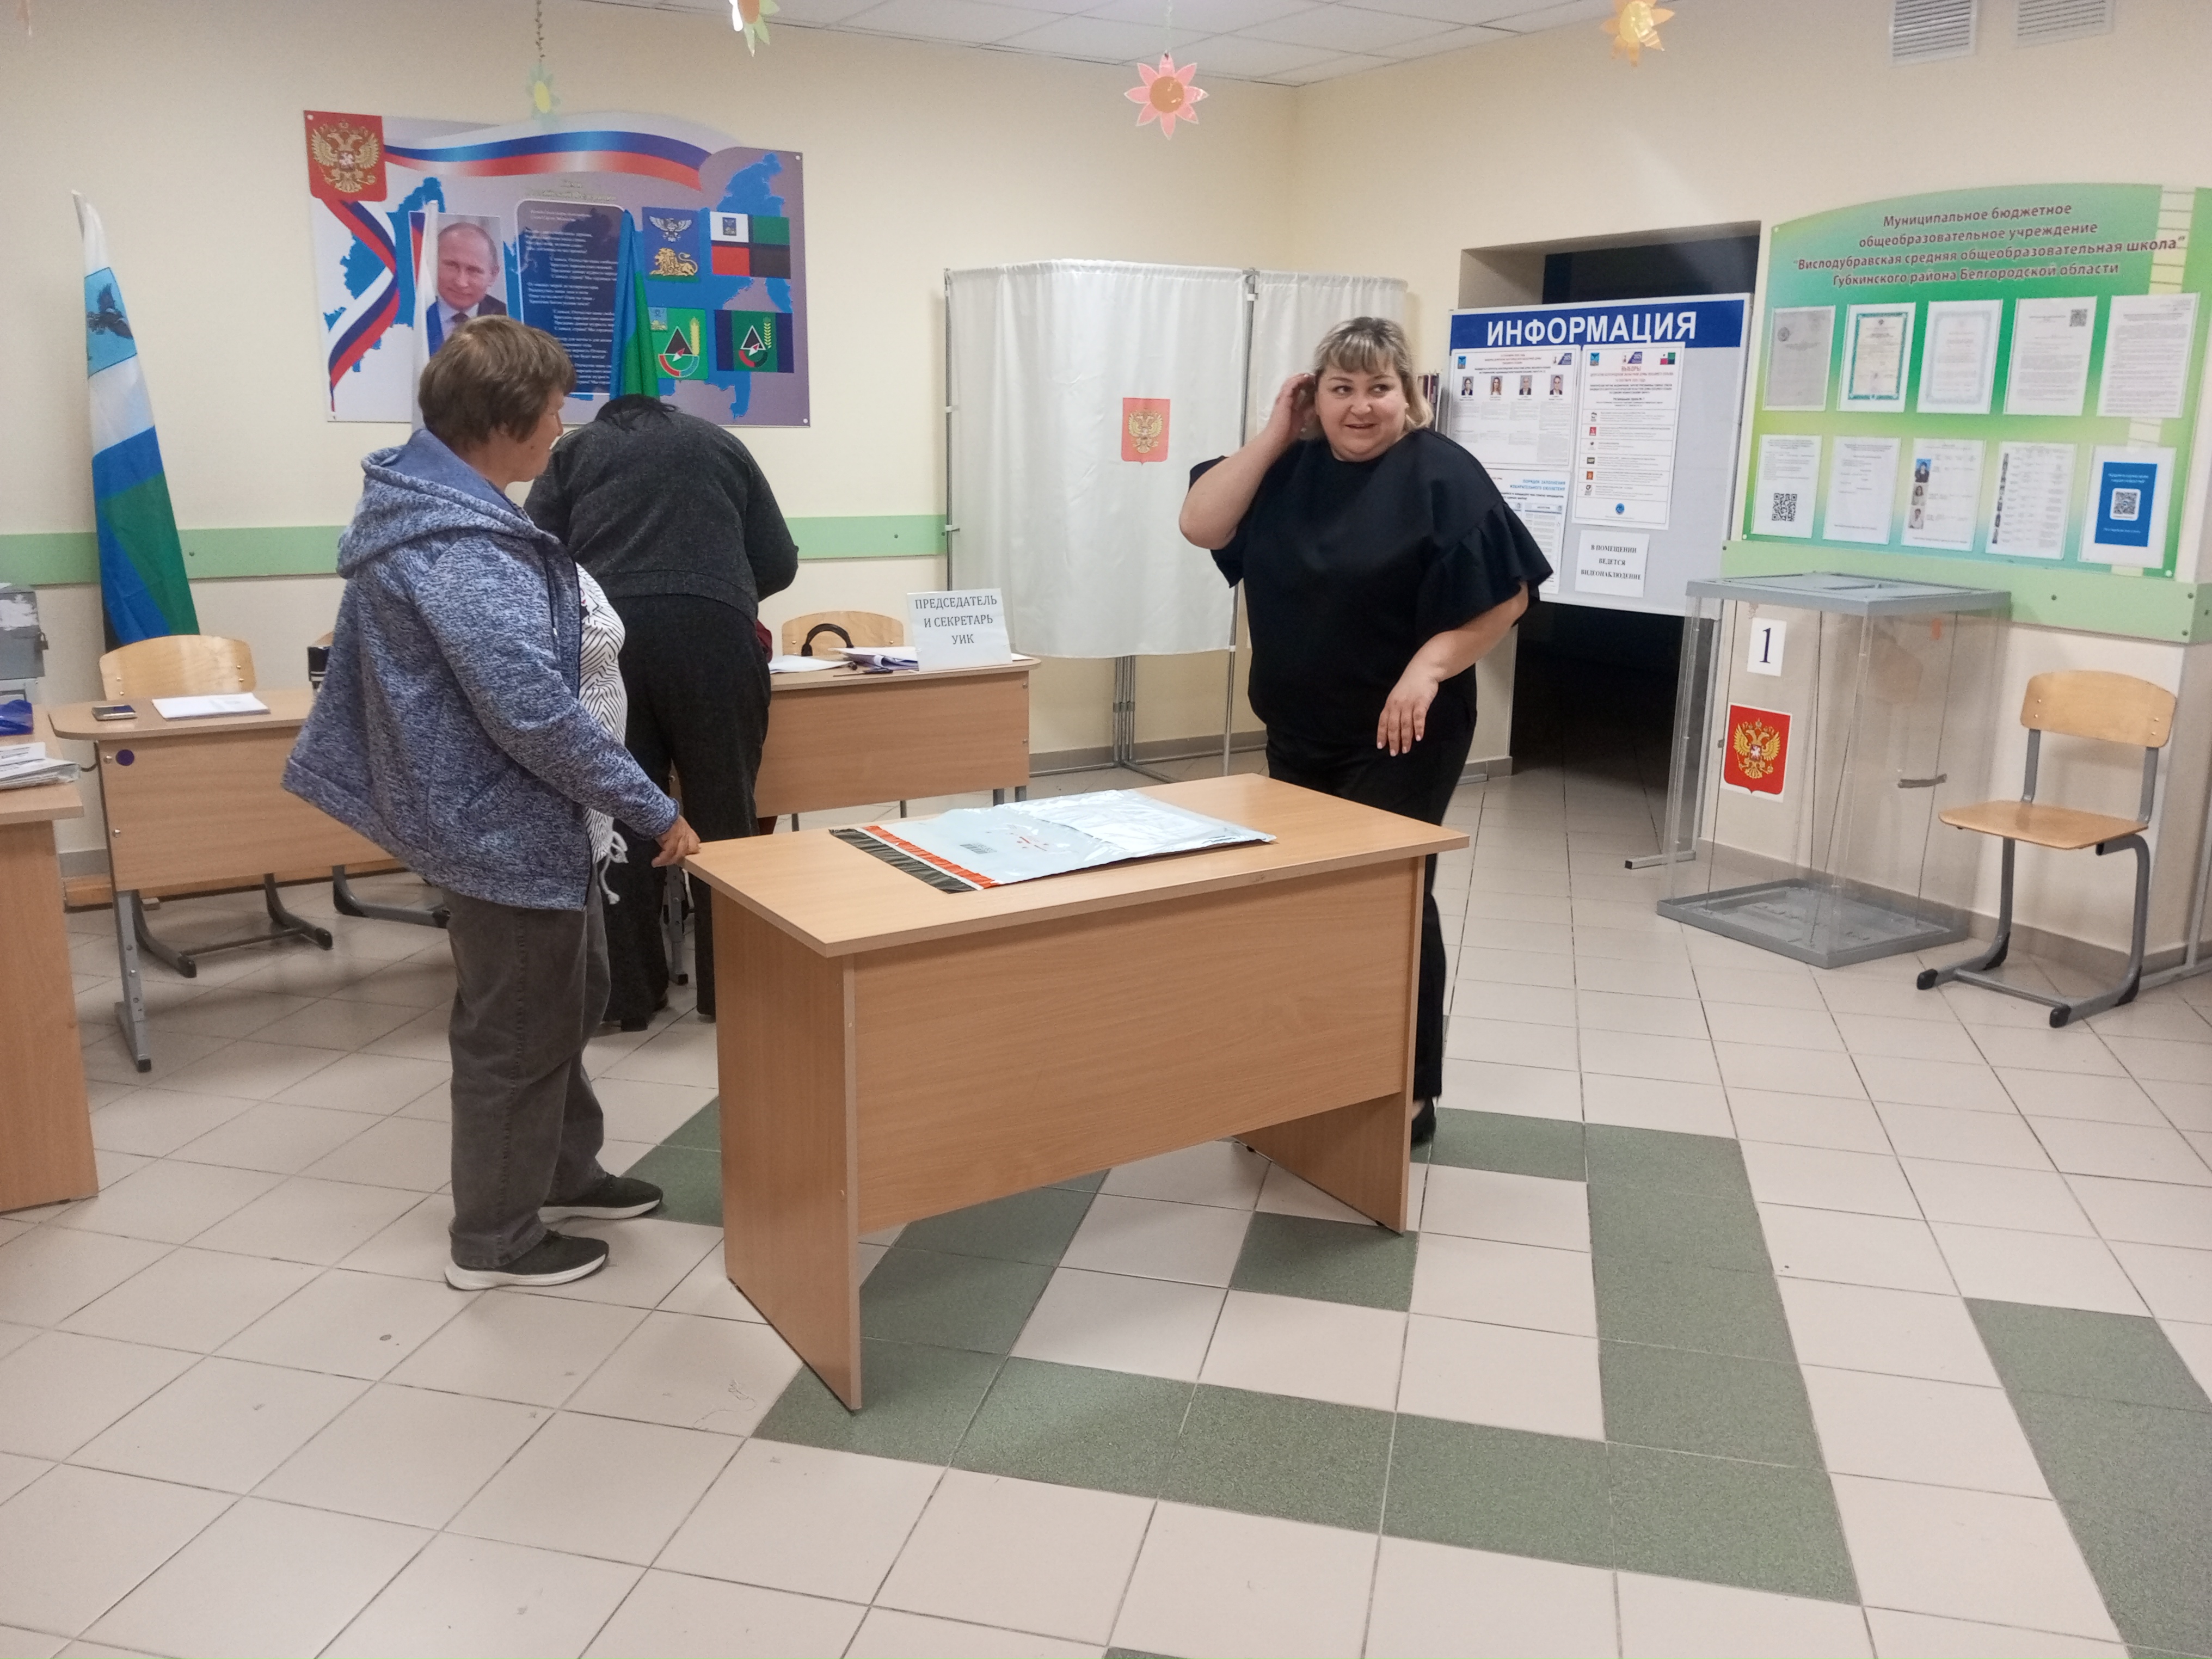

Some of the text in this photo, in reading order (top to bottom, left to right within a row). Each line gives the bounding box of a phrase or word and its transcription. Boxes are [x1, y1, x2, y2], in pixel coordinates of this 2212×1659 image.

[1883, 204, 2072, 229] Муниципальное бюджетное
[1859, 223, 2098, 248] общеобразовательное учреждение
[1905, 251, 1957, 265] средняя
[1960, 242, 2123, 260] общеобразовательная
[1833, 262, 2119, 288] Губкинского района Белгородской области
[1487, 311, 1697, 346] ИНФОРМАЦИЯ
[1596, 545, 1637, 554] ПОМЕЩЕНИИ
[1599, 558, 1626, 566] ВЕДЕТСЯ
[914, 595, 997, 610] ПРЕДСЕДАТЕЛЬ
[924, 614, 993, 628] И СЕКРЕТАРЬ
[951, 634, 974, 645] УИК
[1759, 627, 1771, 664] 1
